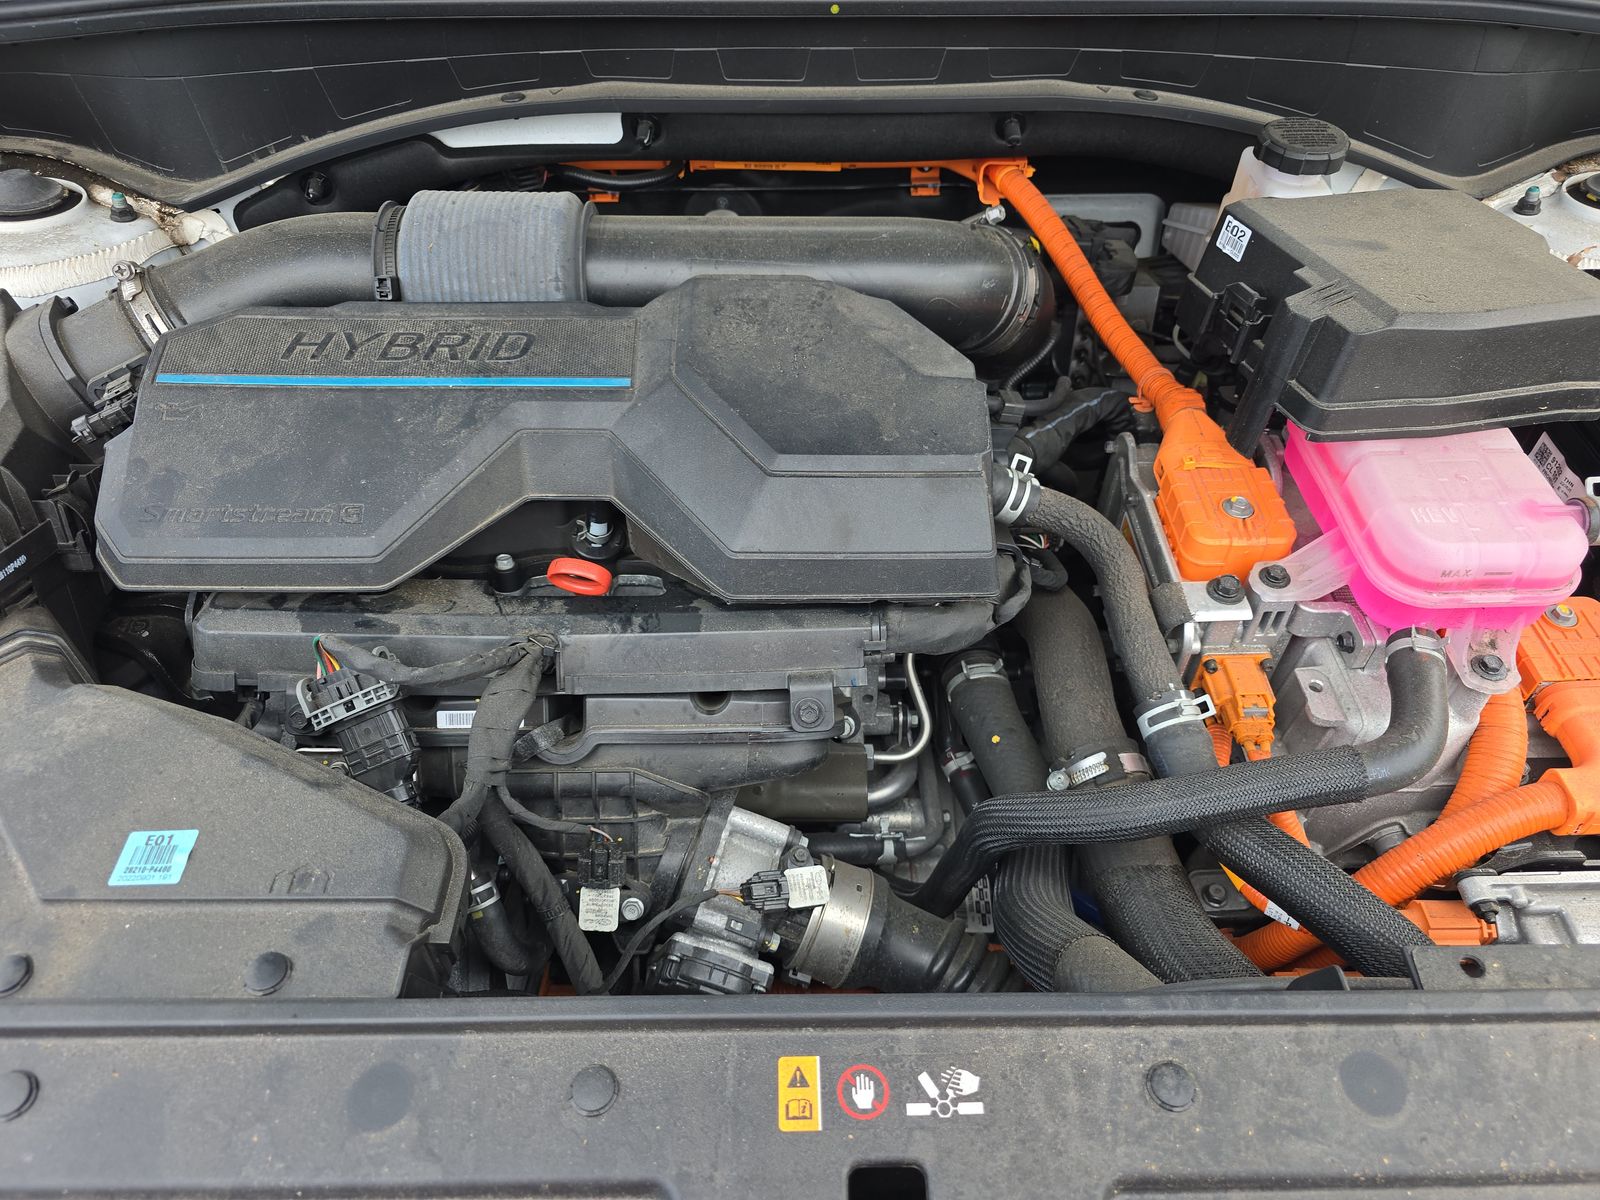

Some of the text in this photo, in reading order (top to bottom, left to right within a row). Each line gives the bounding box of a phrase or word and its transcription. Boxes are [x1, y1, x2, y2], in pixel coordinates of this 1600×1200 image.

[1225, 220, 1246, 243] E02
[281, 331, 537, 361] HYBRID
[139, 503, 364, 523] Smartstream G
[1410, 506, 1459, 523] HEV
[1440, 569, 1472, 578] MAX
[145, 834, 174, 846] E01
